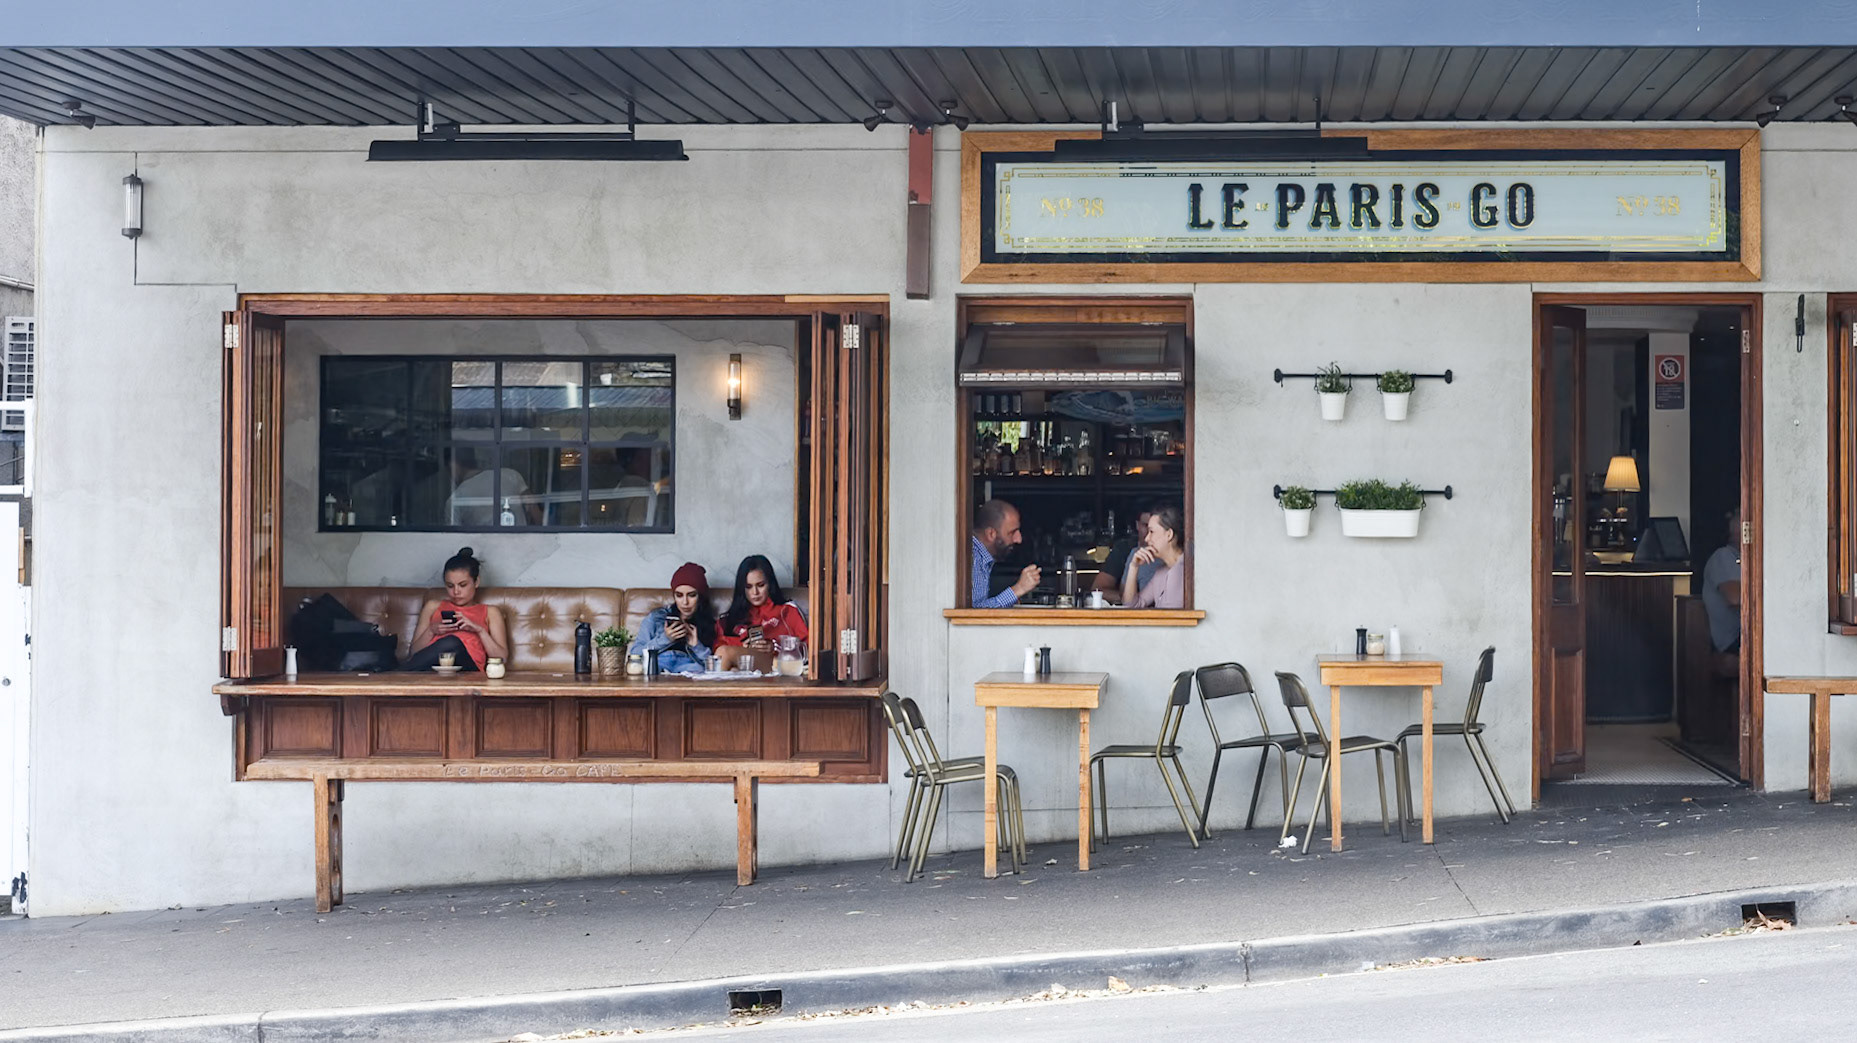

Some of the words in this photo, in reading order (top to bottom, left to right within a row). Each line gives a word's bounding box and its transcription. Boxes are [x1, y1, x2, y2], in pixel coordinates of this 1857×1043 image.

[1077, 197, 1105, 218] 38
[1187, 183, 1249, 229] LE
[1275, 183, 1440, 229] PARIS
[1470, 182, 1535, 229] GO
[1653, 195, 1681, 216] 38
